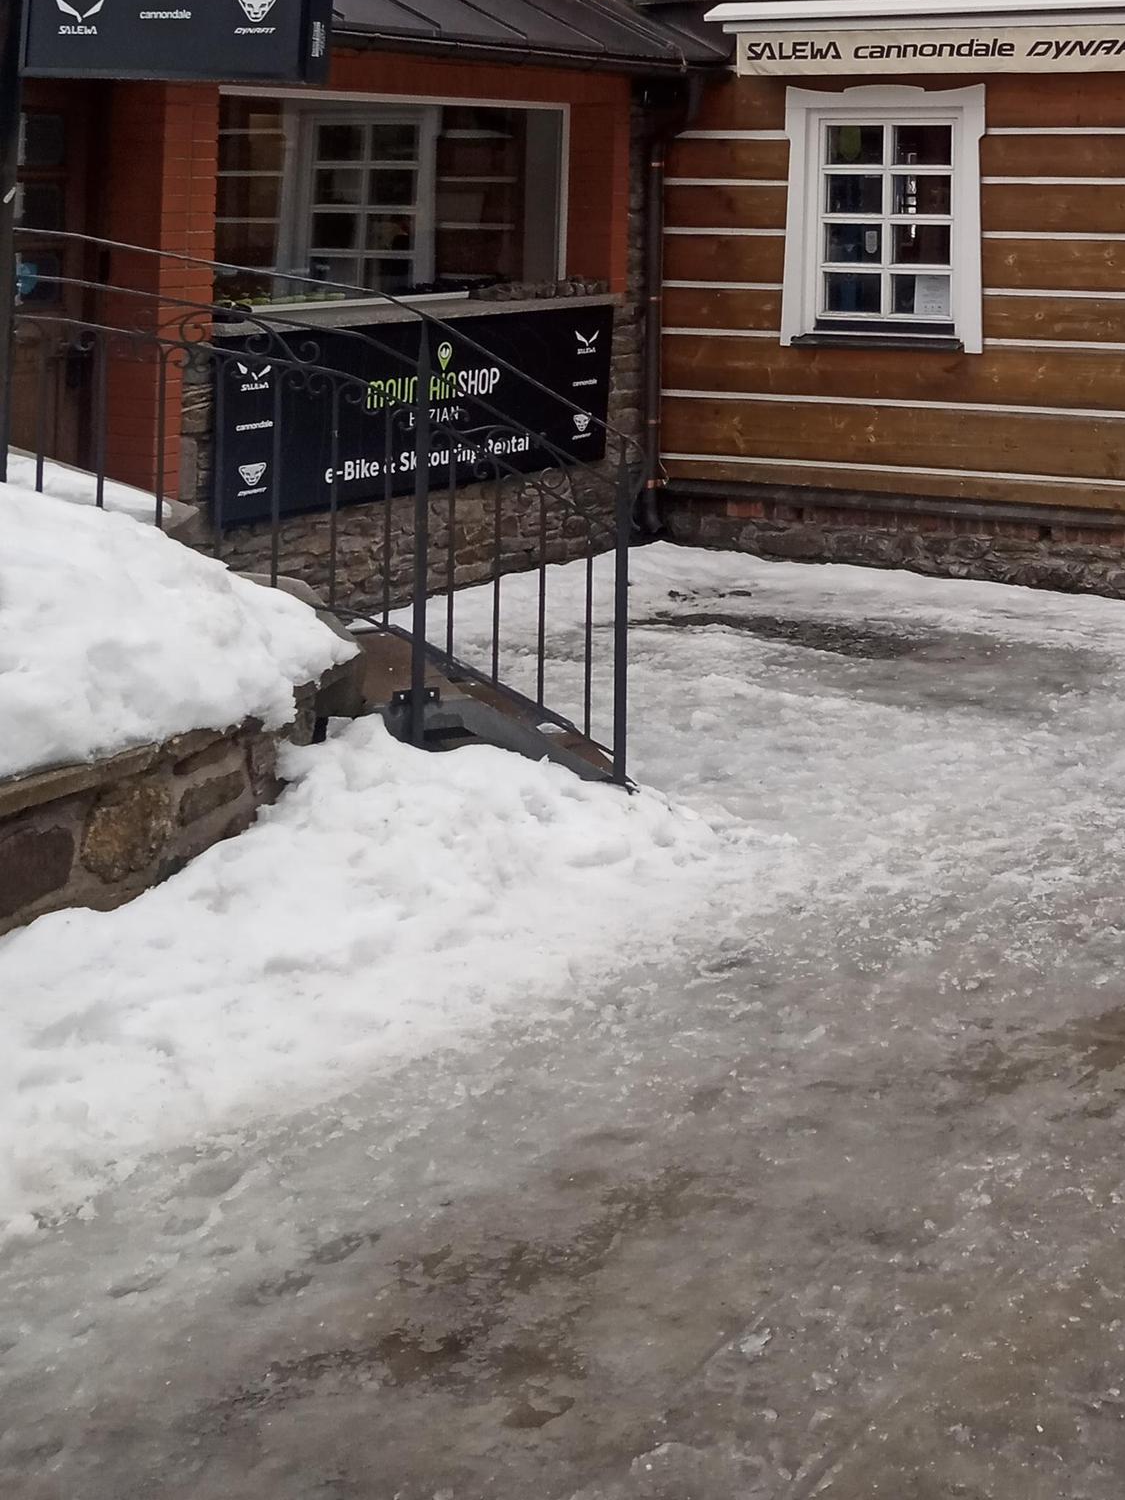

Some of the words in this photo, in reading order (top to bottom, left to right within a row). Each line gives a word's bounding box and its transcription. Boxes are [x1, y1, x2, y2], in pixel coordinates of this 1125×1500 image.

[139, 9, 192, 19] cannondale
[58, 25, 98, 35] SALEWA
[234, 27, 276, 36] DYNAFIT
[746, 41, 842, 61] SALEWA
[853, 38, 1015, 59] cannondale
[366, 372, 457, 410] MOUNAIN
[458, 367, 501, 398] SHOP
[325, 458, 380, 484] e-Bike
